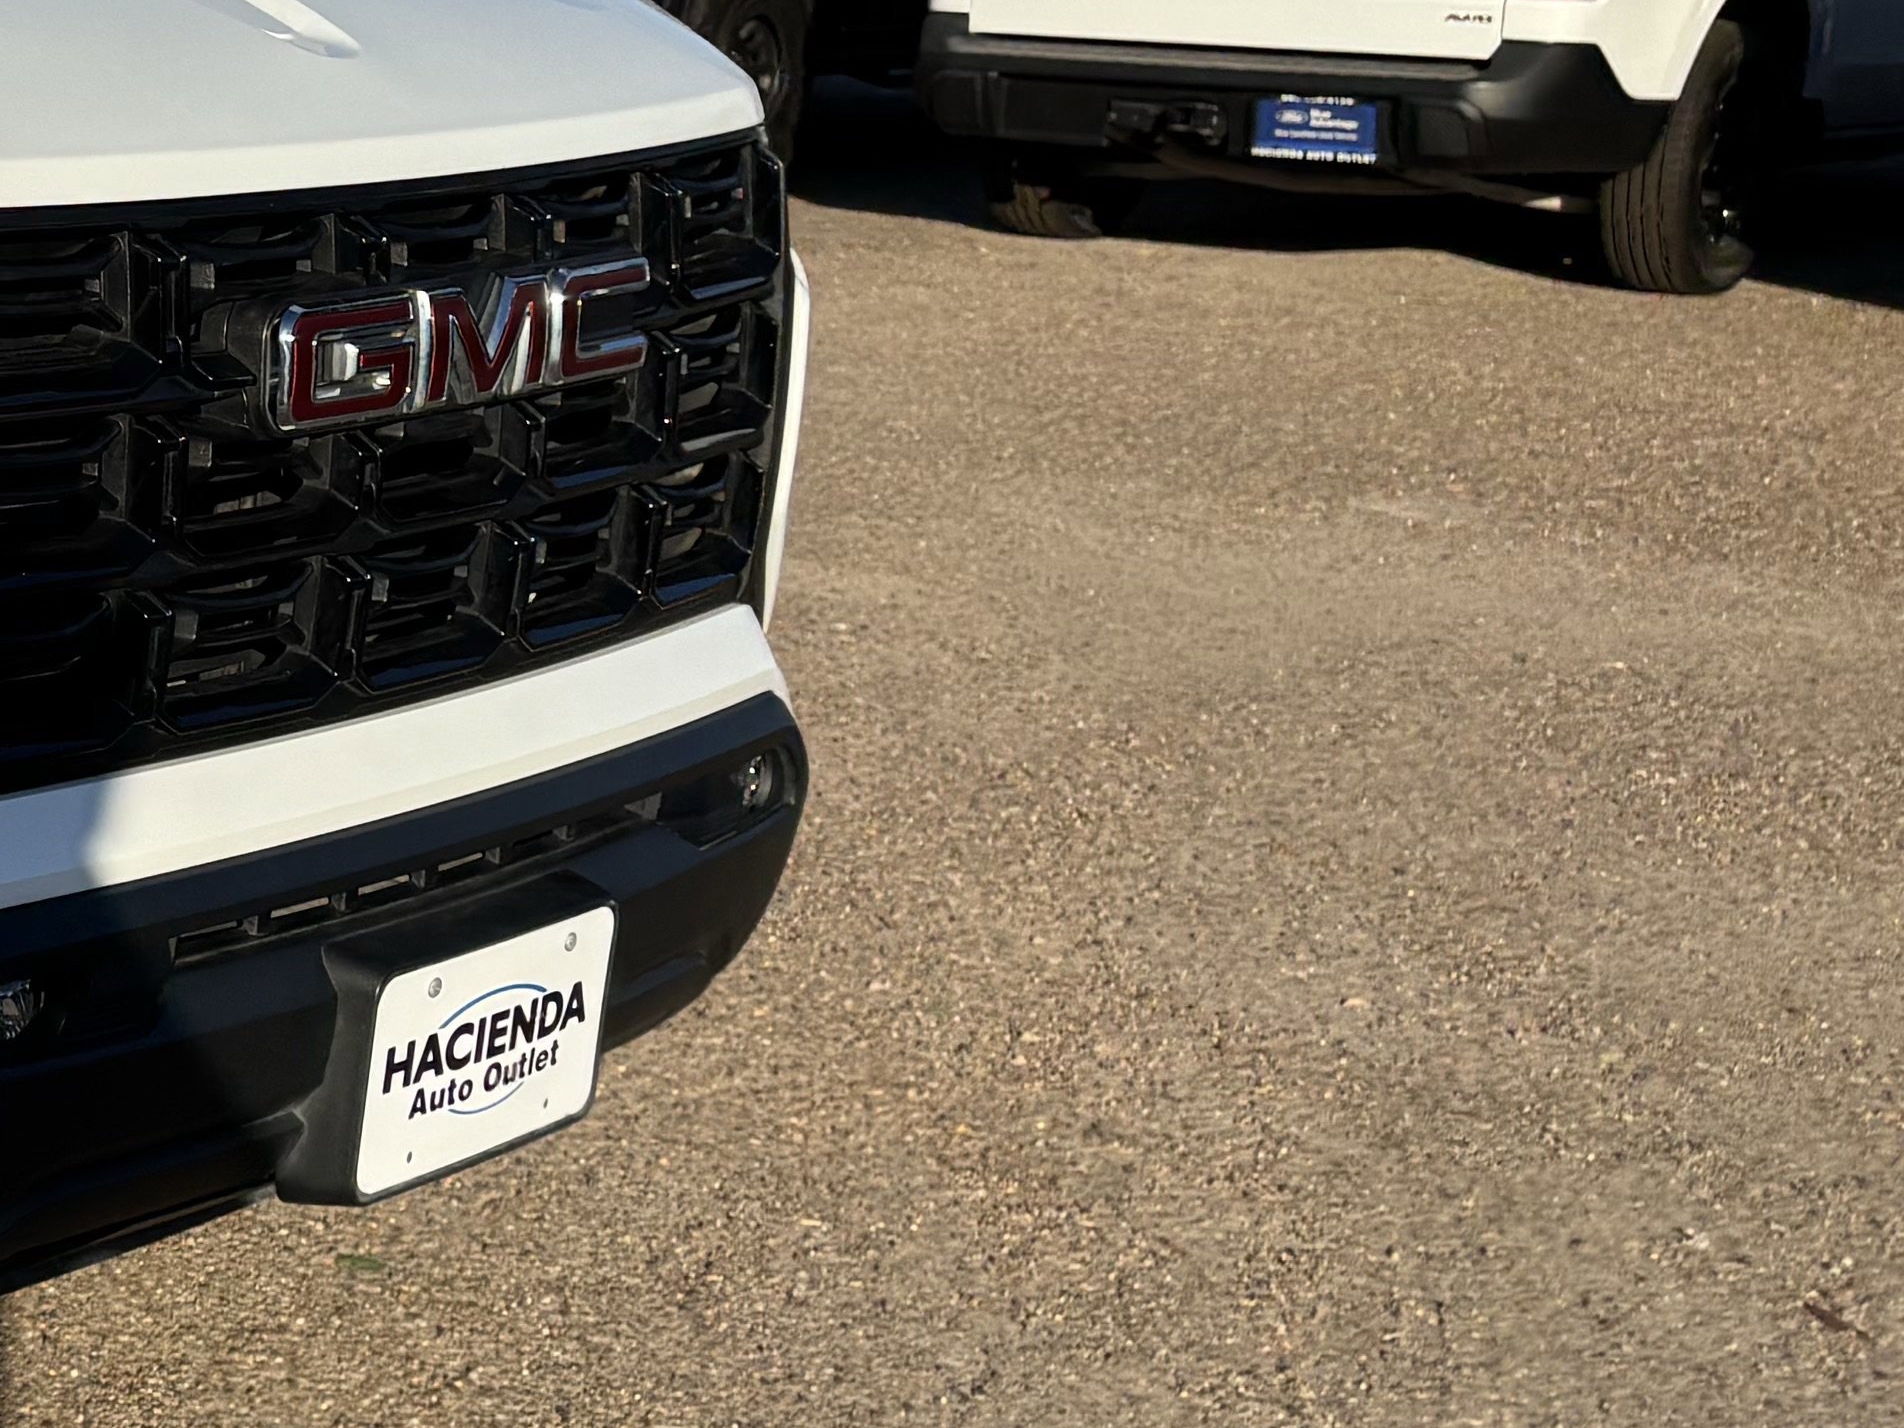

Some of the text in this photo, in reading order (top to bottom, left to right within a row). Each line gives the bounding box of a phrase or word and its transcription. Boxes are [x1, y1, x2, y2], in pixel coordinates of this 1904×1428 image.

[278, 257, 649, 430] GMC
[382, 981, 585, 1094] HACIENDA
[408, 1040, 559, 1120] Auto Outlet
